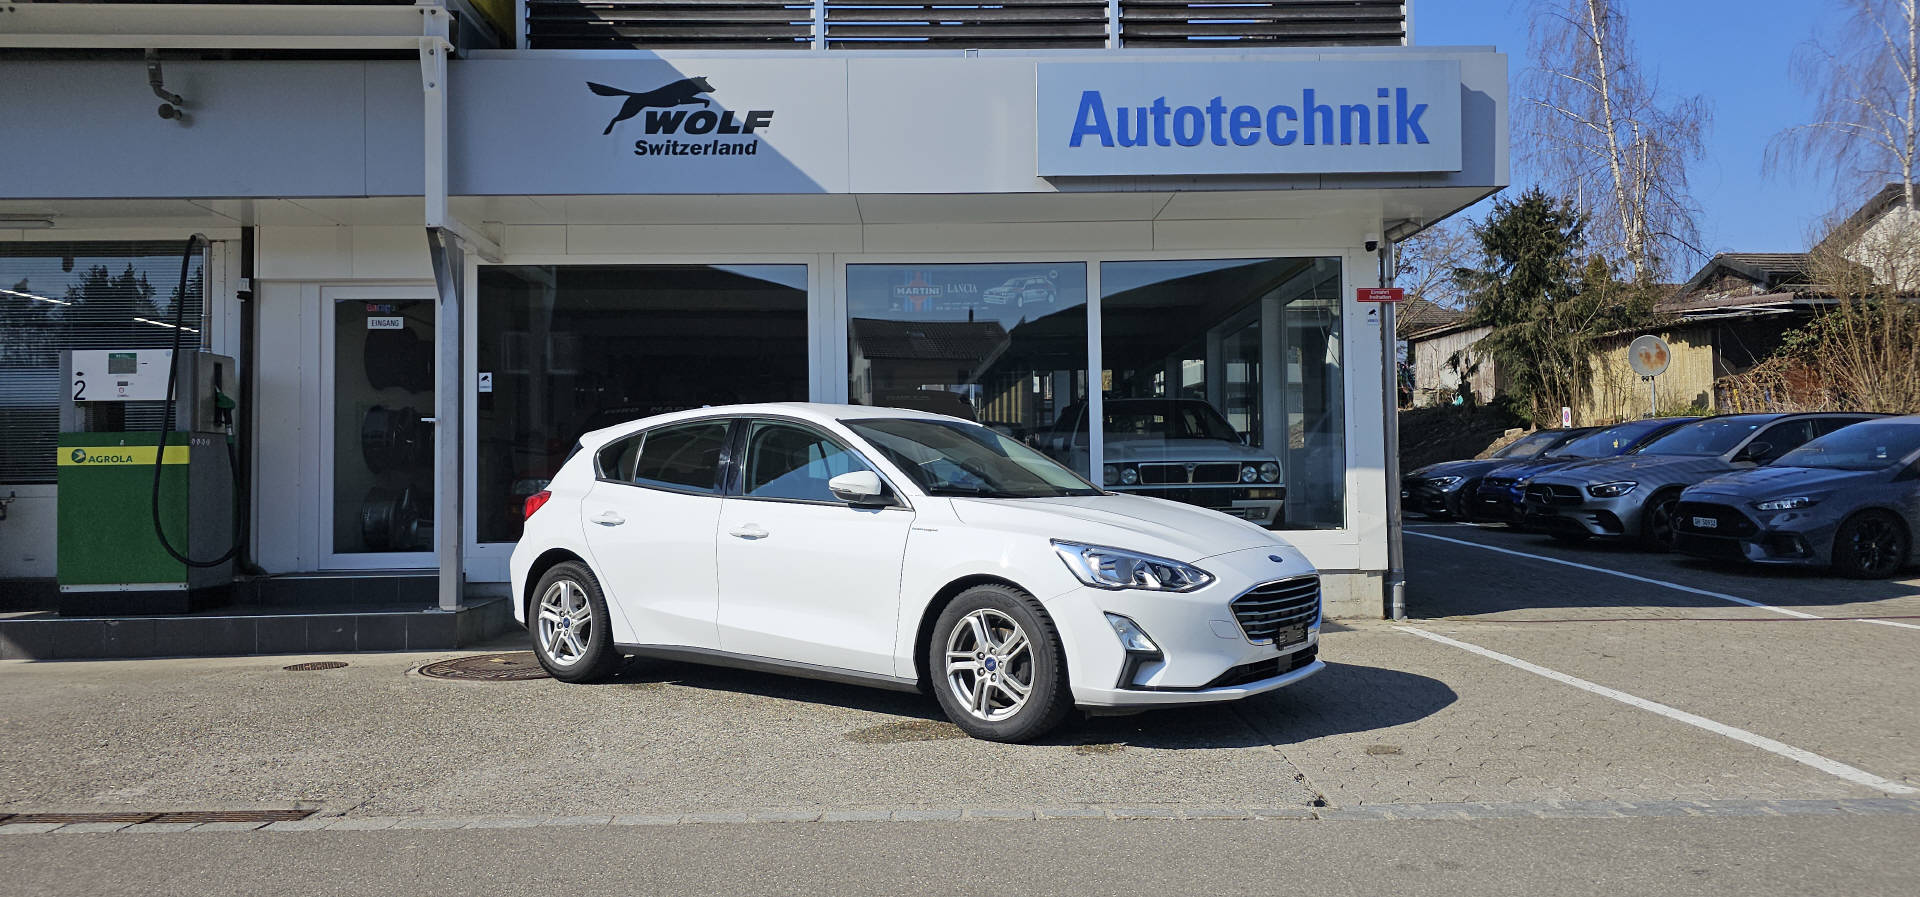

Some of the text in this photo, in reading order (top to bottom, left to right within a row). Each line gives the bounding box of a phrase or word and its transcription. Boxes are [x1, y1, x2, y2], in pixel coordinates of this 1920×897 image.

[644, 110, 775, 135] WOLF
[1069, 87, 1431, 148] Autotechnik
[633, 139, 758, 156] Switzerland
[896, 287, 940, 295] MARTINI
[946, 283, 978, 293] LANCIA
[371, 319, 400, 327] EINGANG
[73, 380, 86, 400] 2
[88, 455, 133, 463] AGROLA
